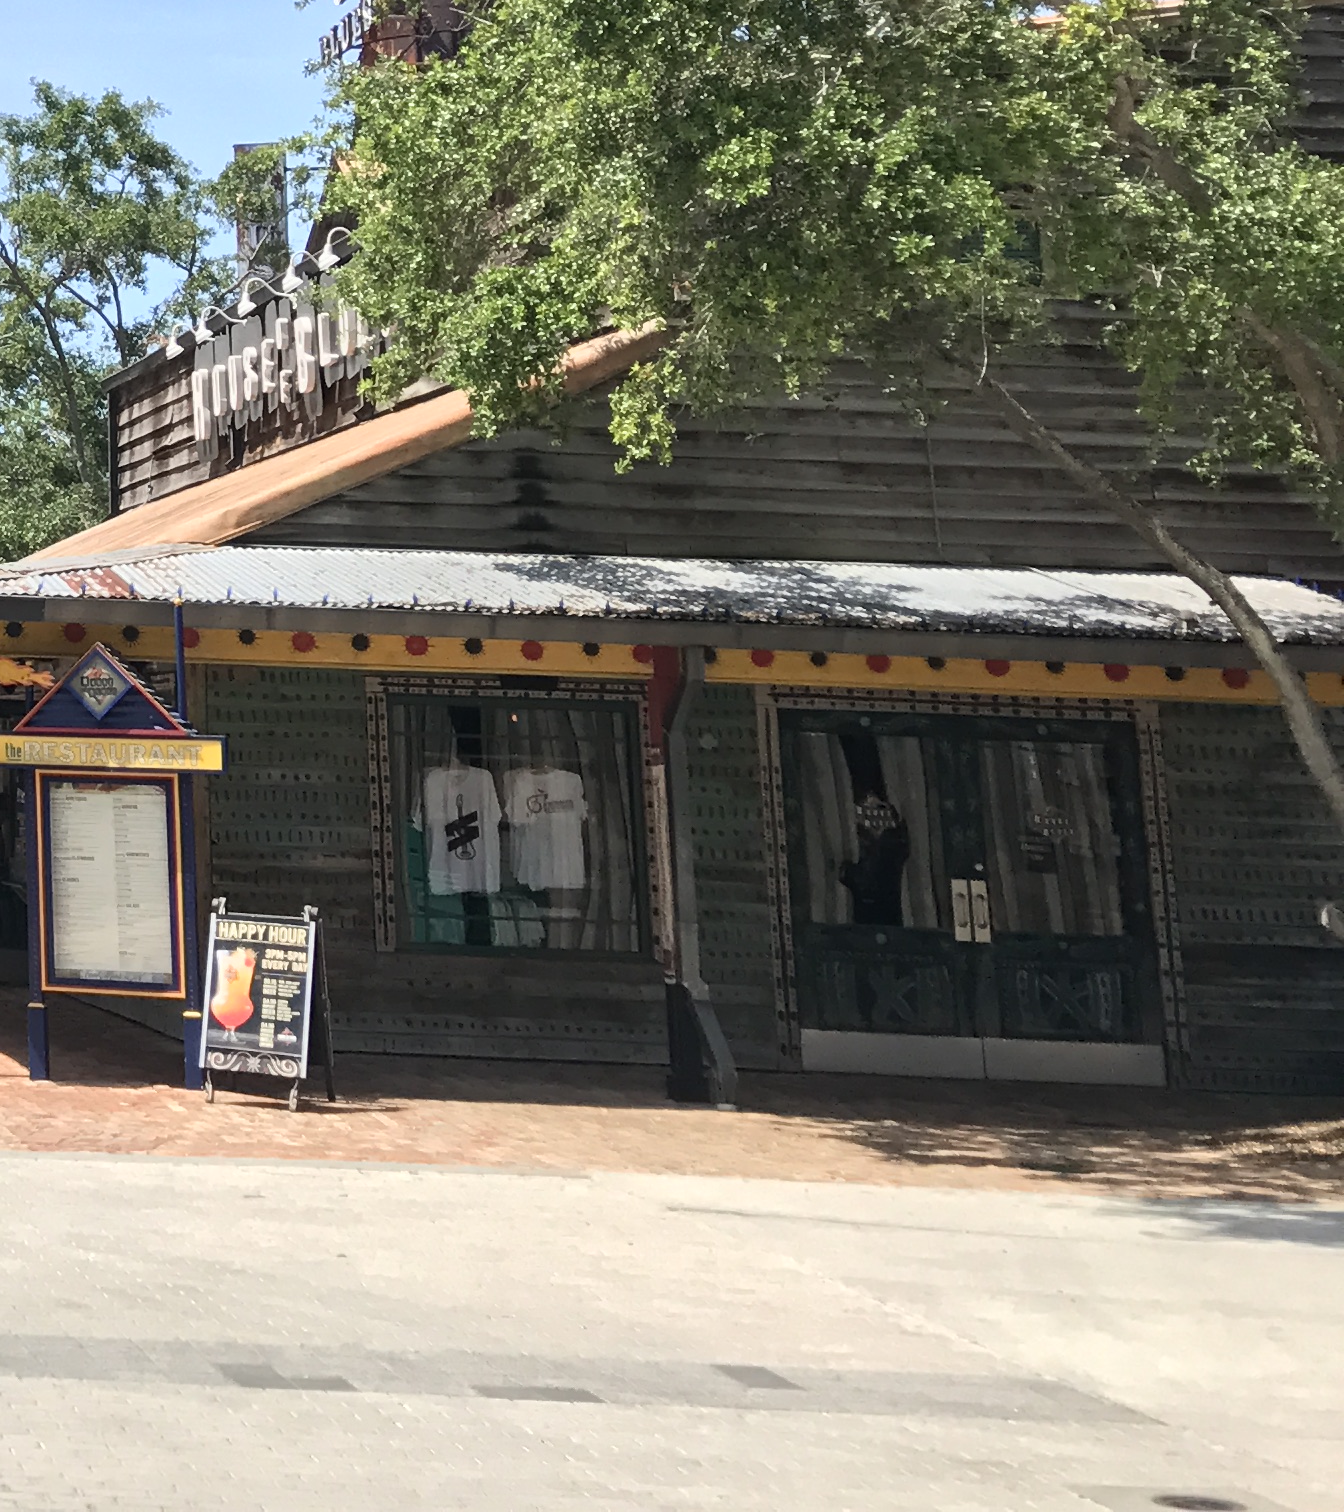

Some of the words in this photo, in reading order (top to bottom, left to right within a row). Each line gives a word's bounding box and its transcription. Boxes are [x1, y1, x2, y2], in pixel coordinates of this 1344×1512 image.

[191, 338, 277, 441] HOUSE
[5, 742, 22, 761] the
[23, 740, 202, 767] RESTAURANT
[218, 921, 266, 941] HAPPY
[269, 925, 307, 944] HOUR
[262, 958, 289, 971] EVERY
